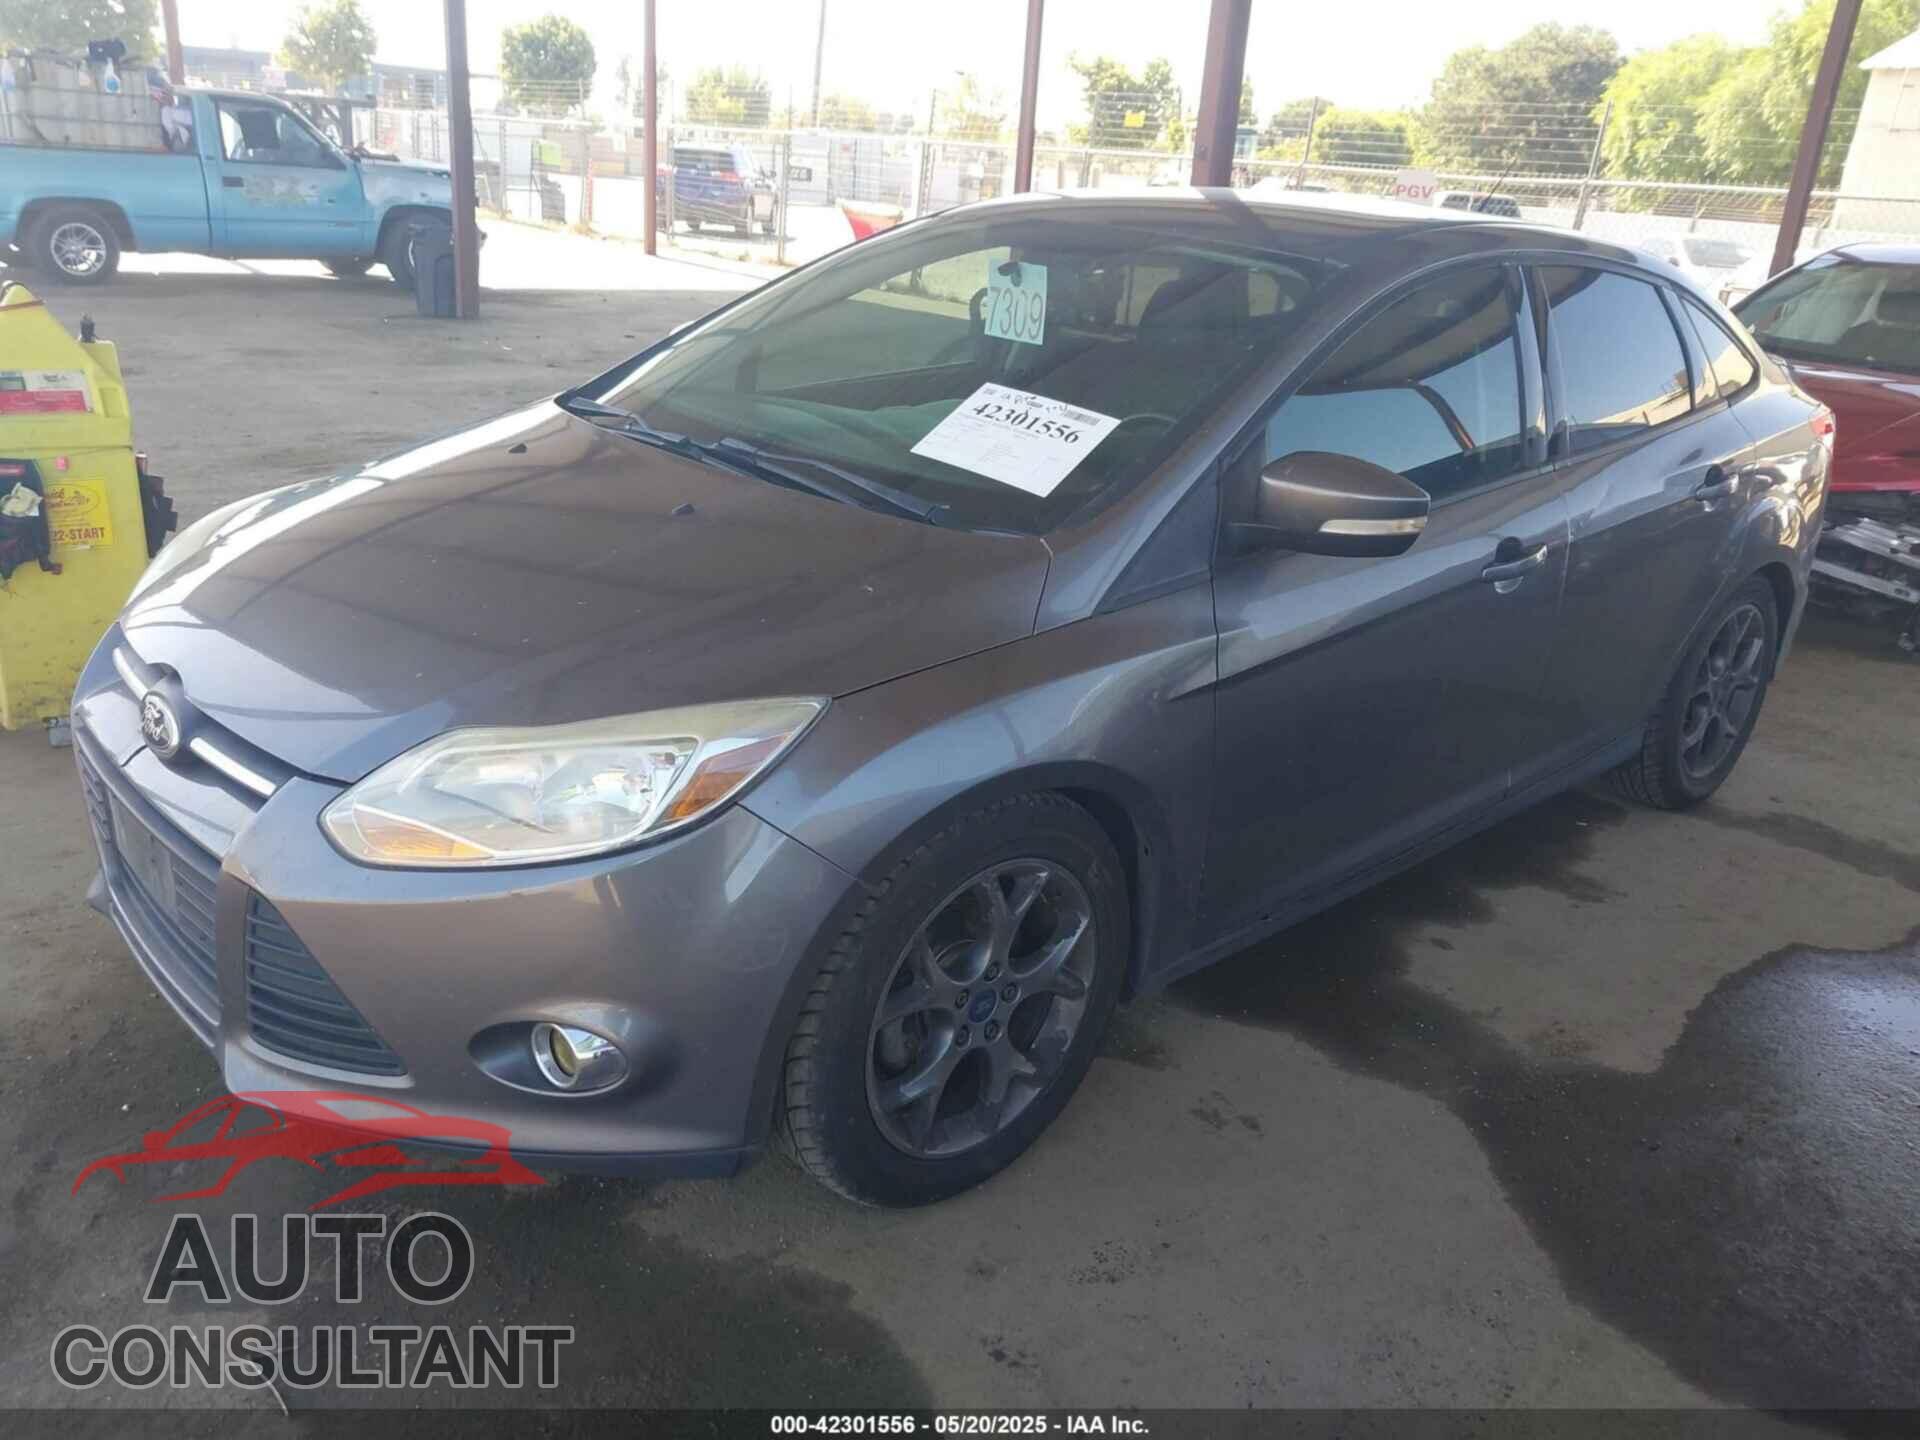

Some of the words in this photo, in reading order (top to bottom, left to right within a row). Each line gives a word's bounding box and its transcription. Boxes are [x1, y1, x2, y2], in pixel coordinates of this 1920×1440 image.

[1396, 184, 1434, 199] PGV
[987, 287, 1044, 340] 7309
[973, 402, 1084, 444] 42301556
